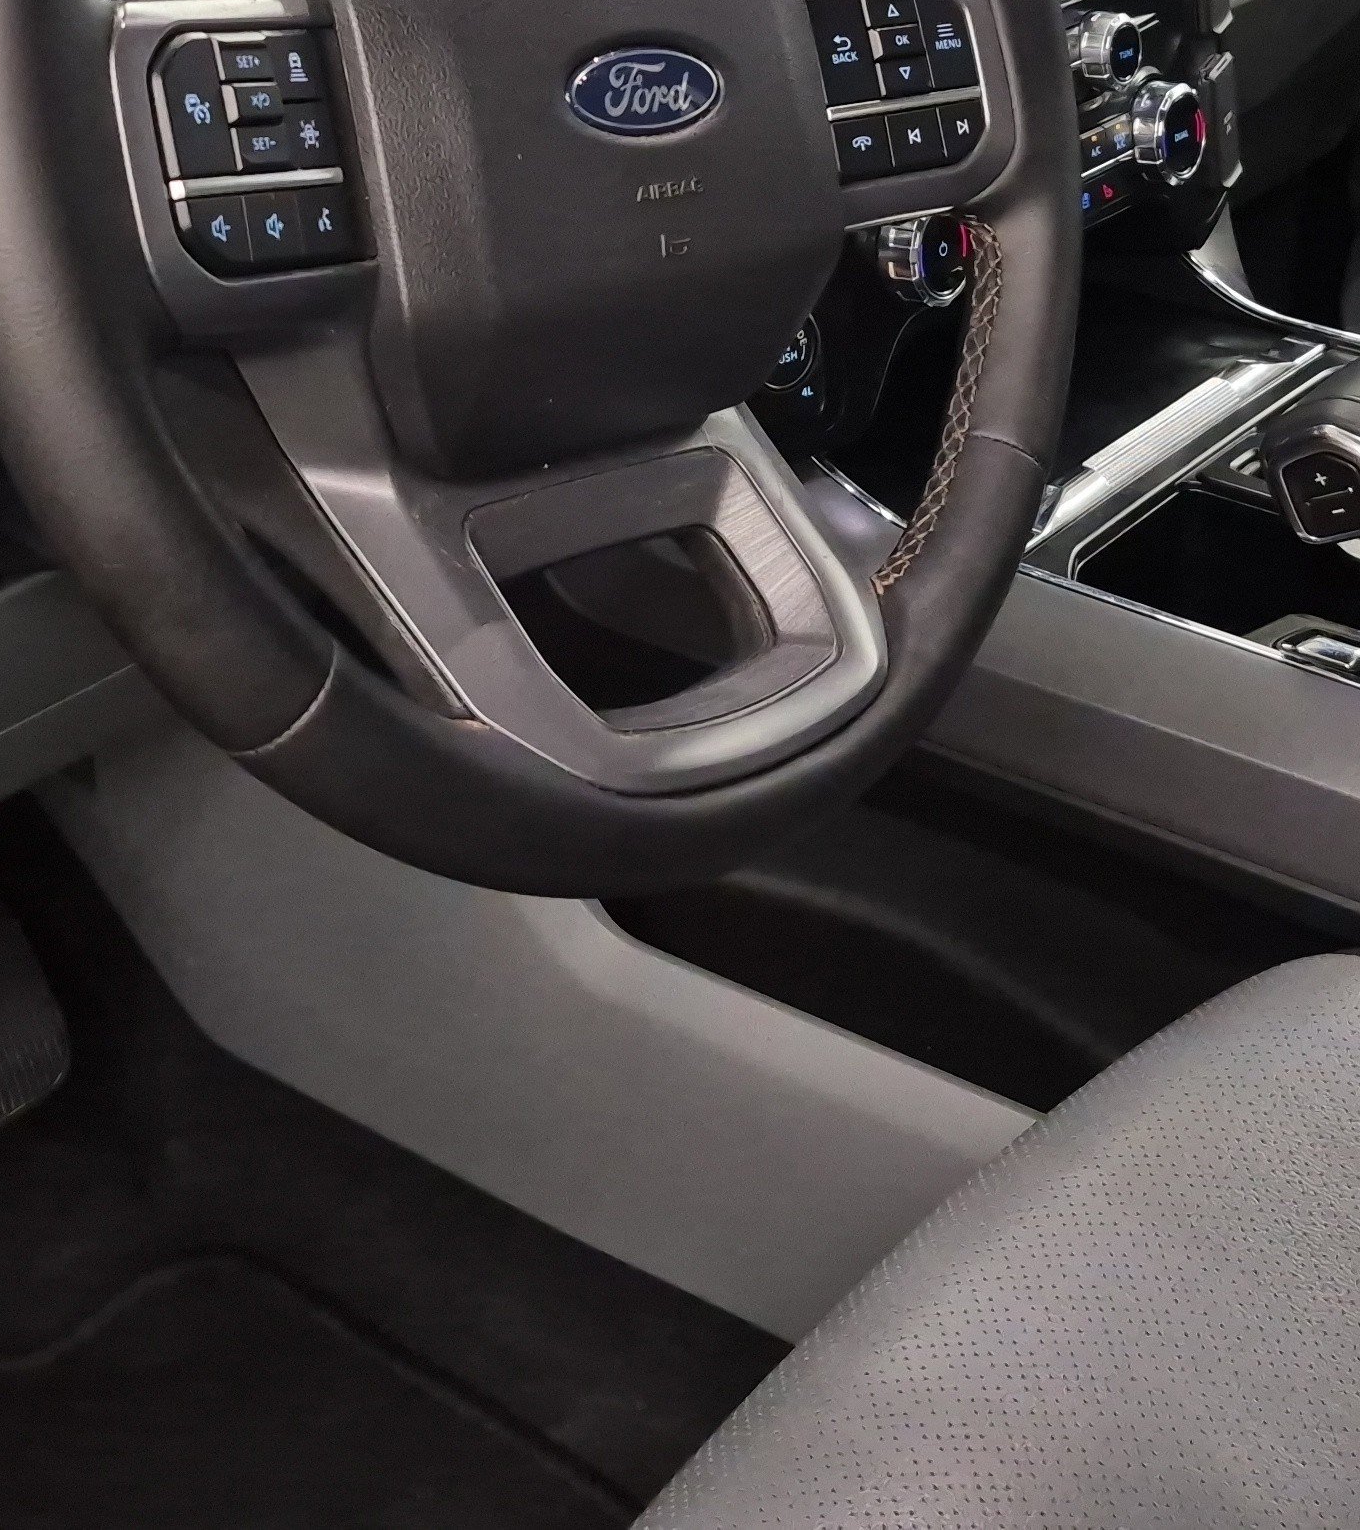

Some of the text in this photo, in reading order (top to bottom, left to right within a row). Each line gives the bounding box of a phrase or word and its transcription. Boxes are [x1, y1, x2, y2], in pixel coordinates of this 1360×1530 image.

[895, 34, 910, 46] OK
[935, 38, 962, 50] MENU
[831, 51, 859, 65] BACK
[604, 61, 692, 118] Ford
[801, 386, 814, 397] 4L
